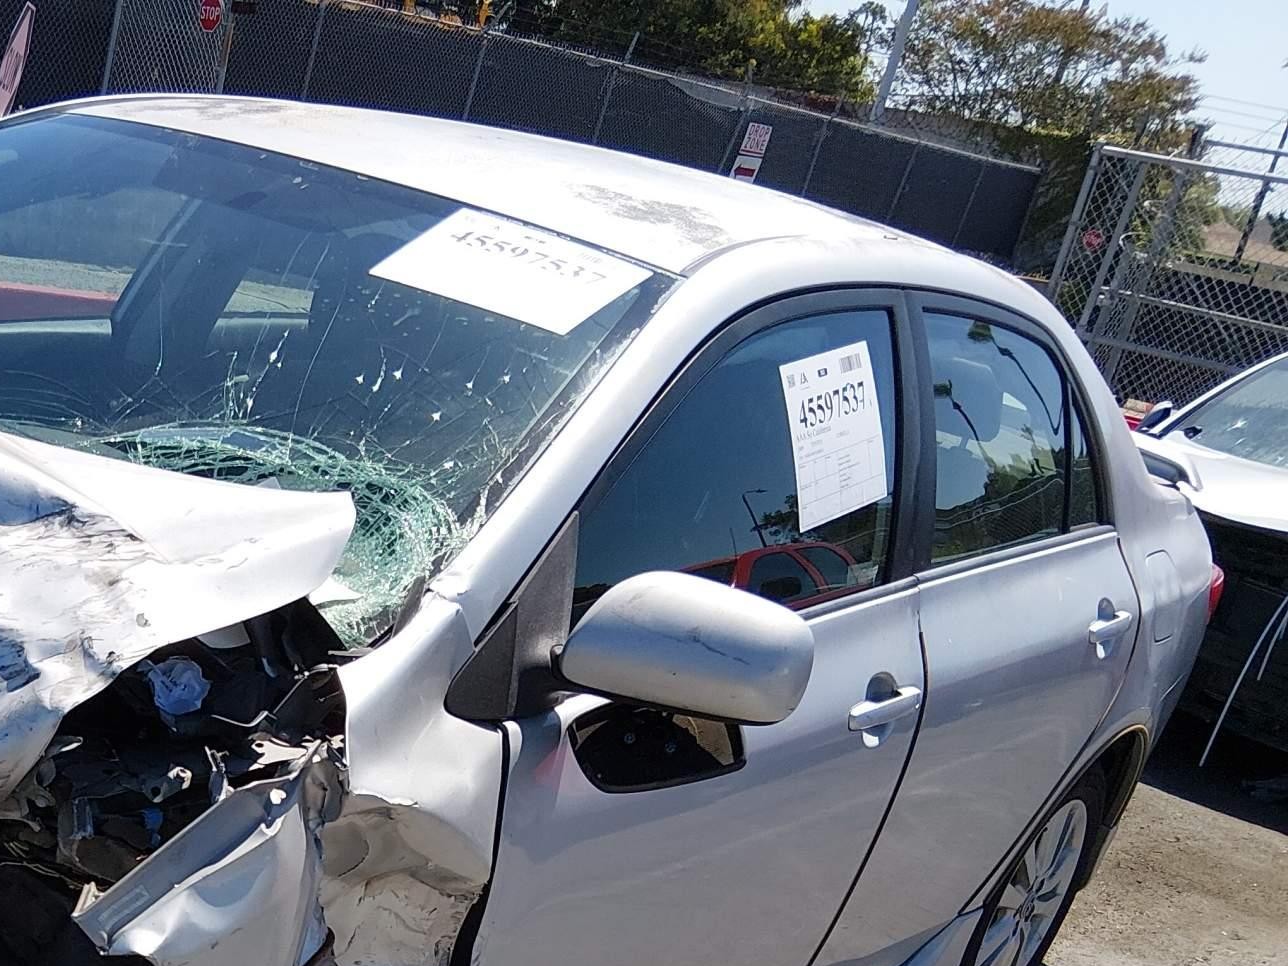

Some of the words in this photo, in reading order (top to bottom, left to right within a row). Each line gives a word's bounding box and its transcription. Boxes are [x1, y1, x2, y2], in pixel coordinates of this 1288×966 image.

[200, 6, 220, 20] STOP
[748, 124, 771, 137] DROP
[743, 136, 767, 151] ZONE
[449, 231, 607, 284] 45597537
[799, 380, 865, 429] 45597537
